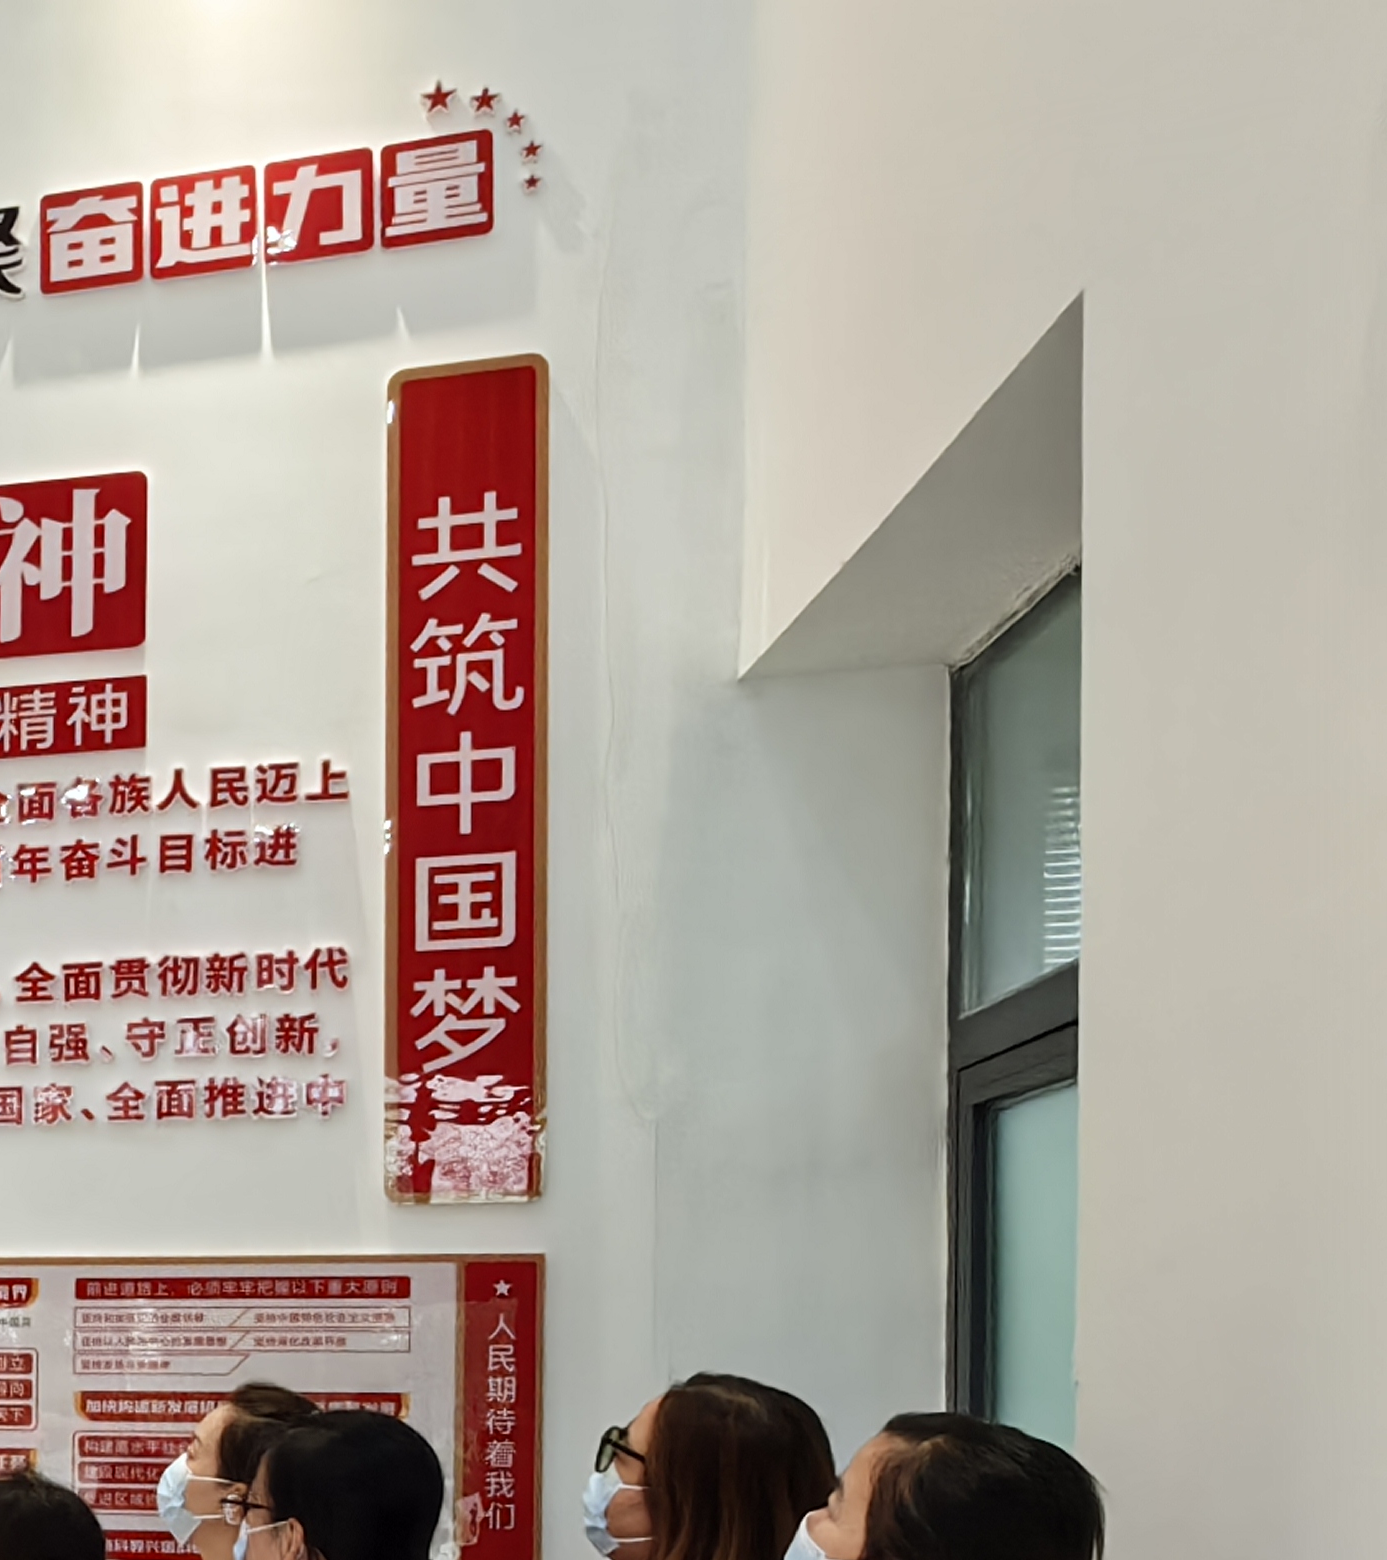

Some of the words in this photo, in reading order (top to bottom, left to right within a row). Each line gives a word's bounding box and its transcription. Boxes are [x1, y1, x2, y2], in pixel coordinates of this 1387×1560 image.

[409, 490, 525, 1074] 共筑中国梦
[484, 1312, 517, 1532] 人民期待着我们
